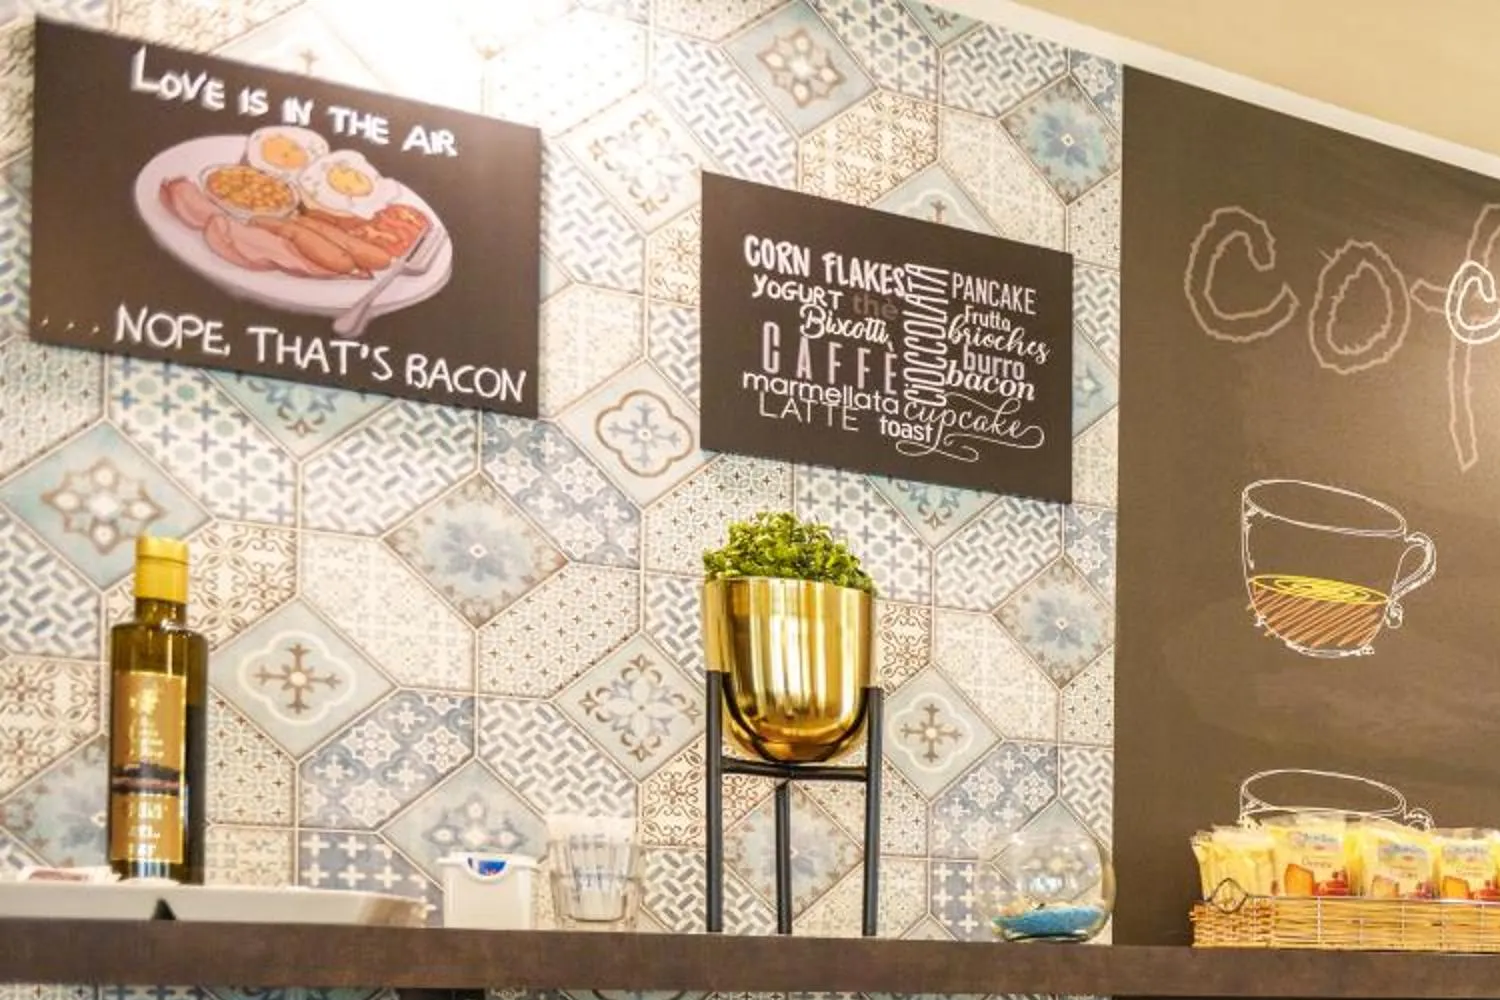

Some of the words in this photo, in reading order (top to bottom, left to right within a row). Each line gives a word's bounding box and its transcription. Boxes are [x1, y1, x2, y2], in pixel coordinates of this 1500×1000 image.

[131, 47, 225, 112] LOVE
[239, 86, 268, 117] IS
[282, 95, 313, 127] IN
[327, 106, 390, 145] THE
[403, 125, 458, 158] AIR
[744, 234, 811, 278] CORN
[822, 251, 906, 298] FLAKES
[752, 273, 844, 311] YOGURT
[952, 272, 1037, 315] PANCAKE
[800, 303, 890, 344] Biscotti
[948, 312, 1051, 365] brioches
[964, 304, 1012, 332] Frutta
[114, 303, 232, 357] NOPE,
[247, 325, 393, 383] THAT'S
[404, 354, 527, 404] BACON
[763, 321, 899, 395] CAFFÈ
[963, 343, 1026, 382] burro
[743, 371, 900, 415] marmellata
[945, 359, 1035, 401] bacon
[759, 391, 860, 432] LATTE
[879, 415, 936, 443] toast
[897, 393, 1045, 462] cupcake
